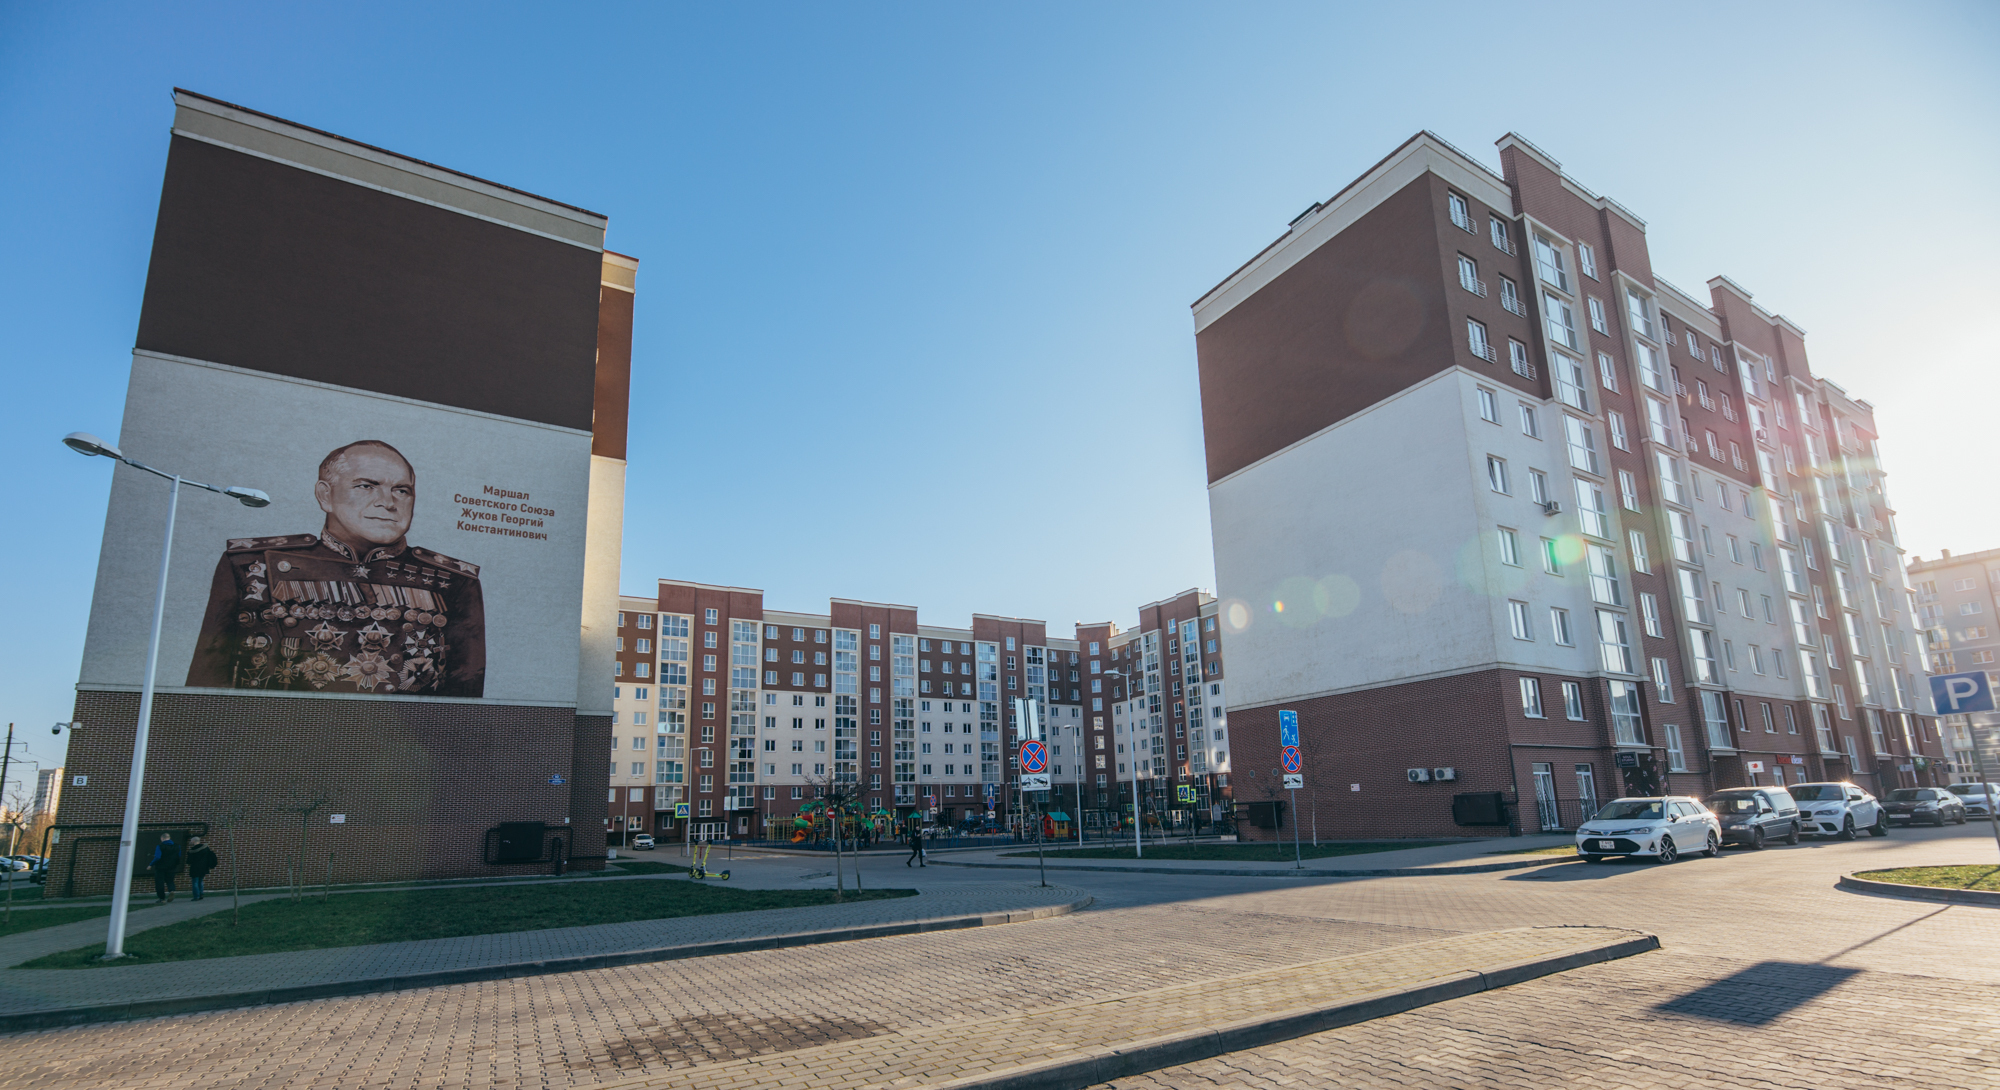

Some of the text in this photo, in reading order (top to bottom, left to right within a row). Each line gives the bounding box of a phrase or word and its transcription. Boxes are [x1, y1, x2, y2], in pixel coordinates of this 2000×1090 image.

[483, 485, 530, 500] Маршал
[454, 494, 555, 517] Советского Союза
[461, 508, 544, 527] Жуков Георгий
[456, 520, 548, 540] Константинович
[1944, 677, 1979, 710] P
